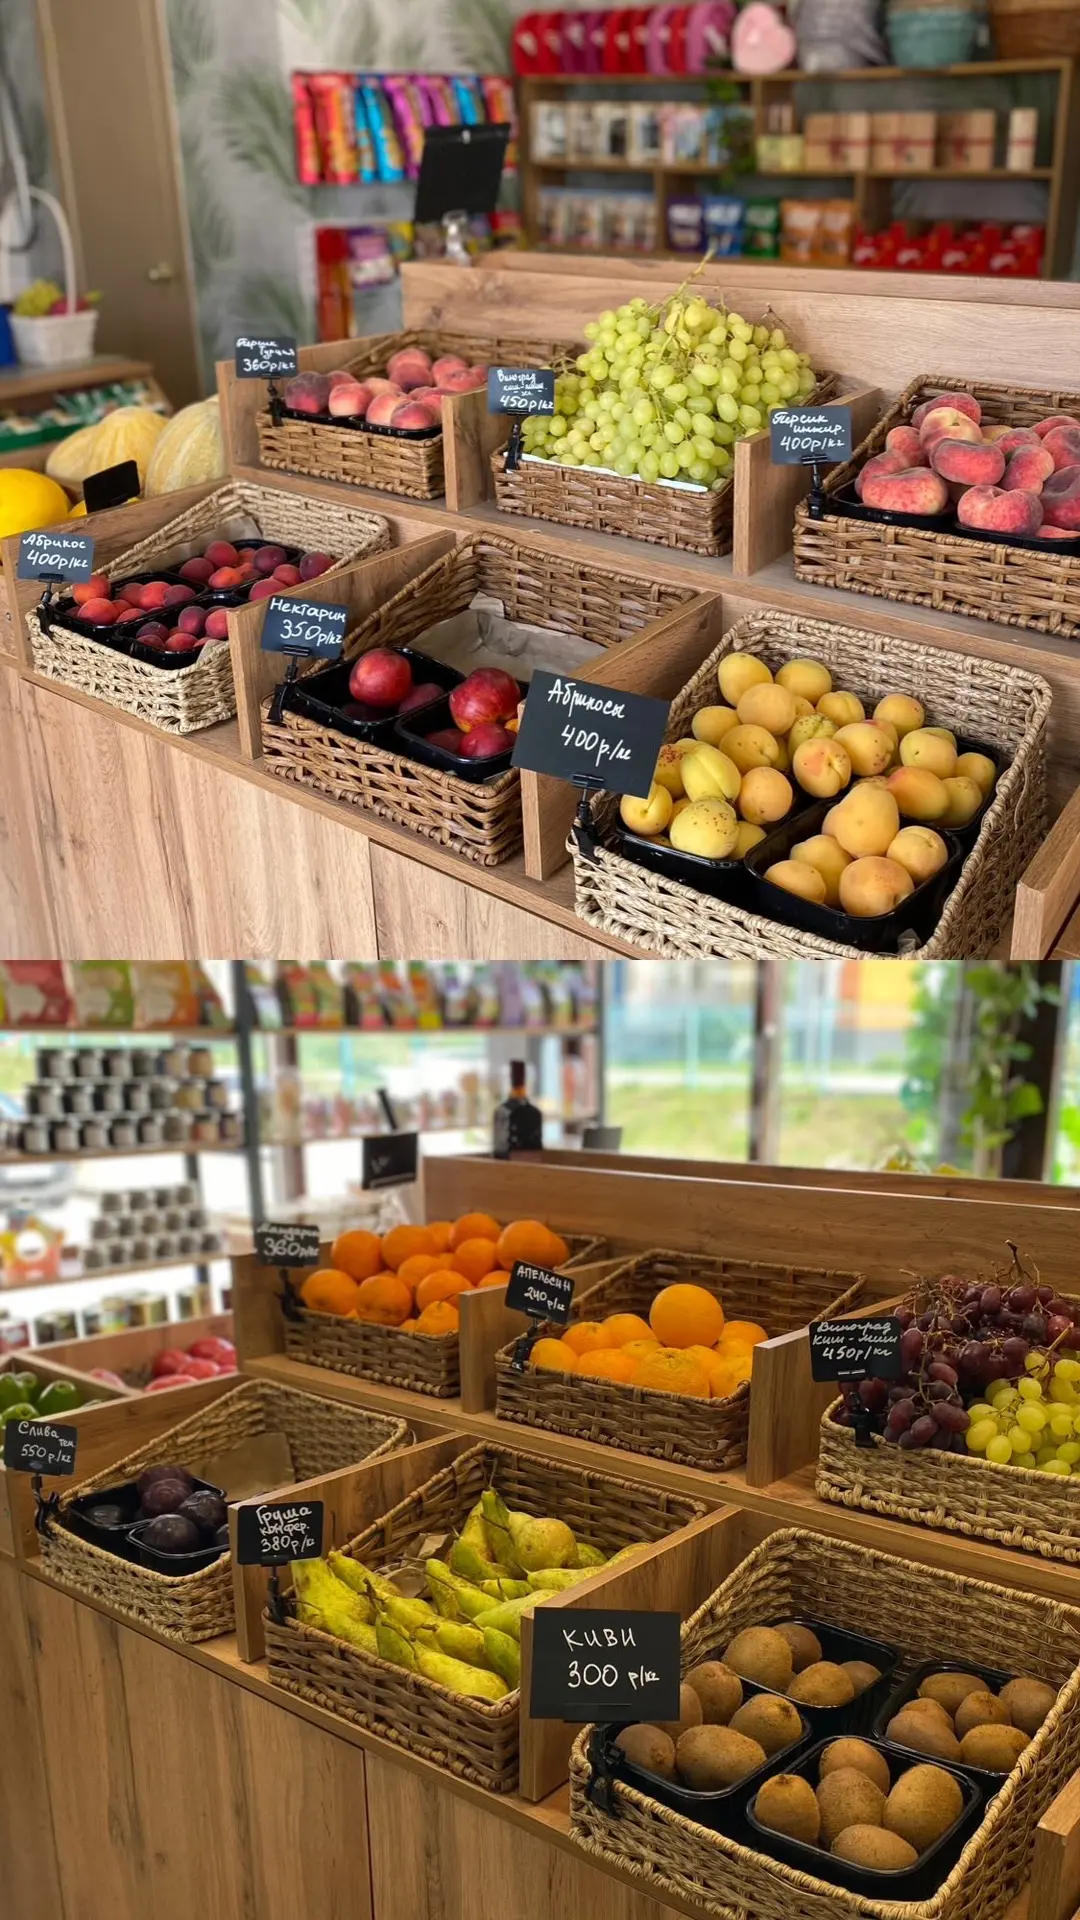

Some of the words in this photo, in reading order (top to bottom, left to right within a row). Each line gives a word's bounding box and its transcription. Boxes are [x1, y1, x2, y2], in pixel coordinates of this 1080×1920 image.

[772, 411, 828, 428] Персик
[793, 424, 845, 436] инжир.
[780, 436, 845, 453] 400р/кг
[22, 534, 86, 550] Абрикос
[27, 549, 88, 570] 400р/кг
[270, 597, 346, 623] Нектарин
[280, 618, 343, 647] 350р/кг
[547, 678, 626, 719] Абрикосы
[817, 1321, 892, 1336] Виноград
[18, 1421, 60, 1439] Слива
[255, 1504, 313, 1530] Груша
